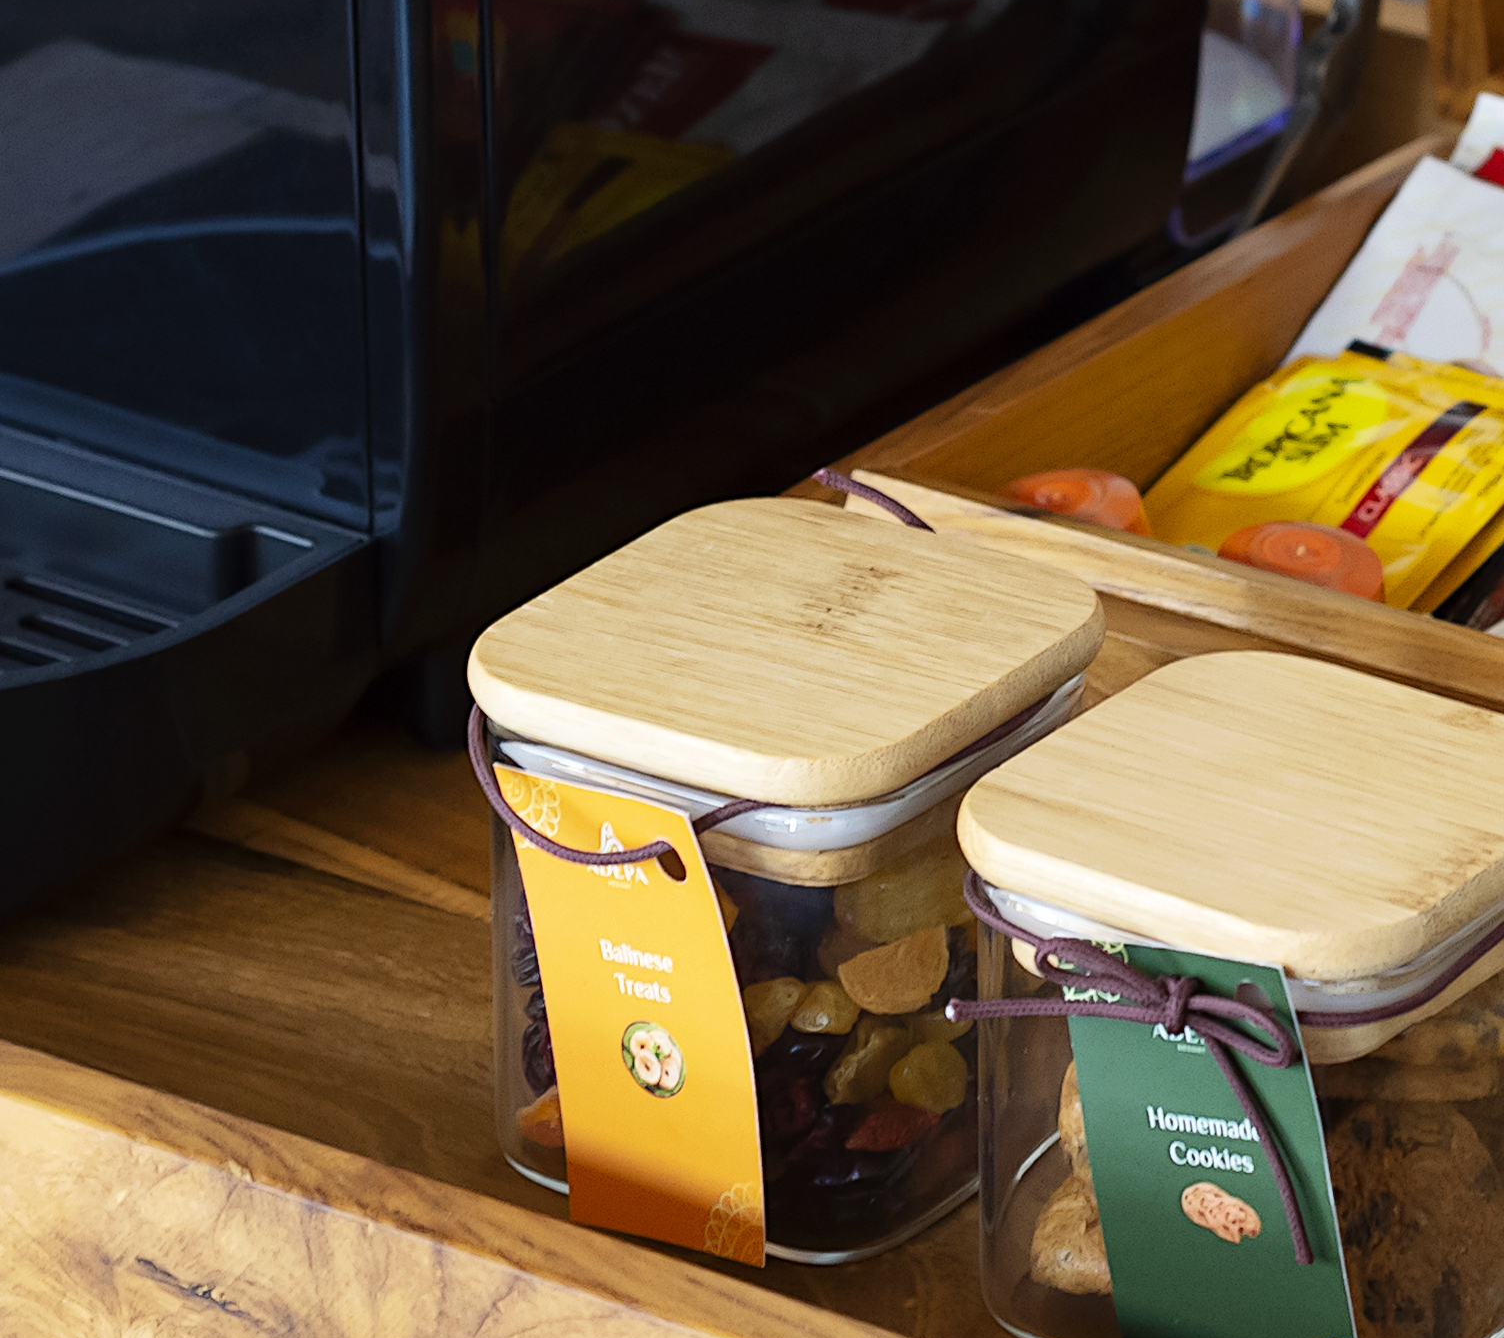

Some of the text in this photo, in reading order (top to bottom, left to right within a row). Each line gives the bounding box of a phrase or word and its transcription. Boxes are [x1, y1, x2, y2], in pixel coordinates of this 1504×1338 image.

[599, 938, 674, 973] Balinese
[613, 971, 672, 1004] Treats
[1169, 1140, 1255, 1174] Cookies
